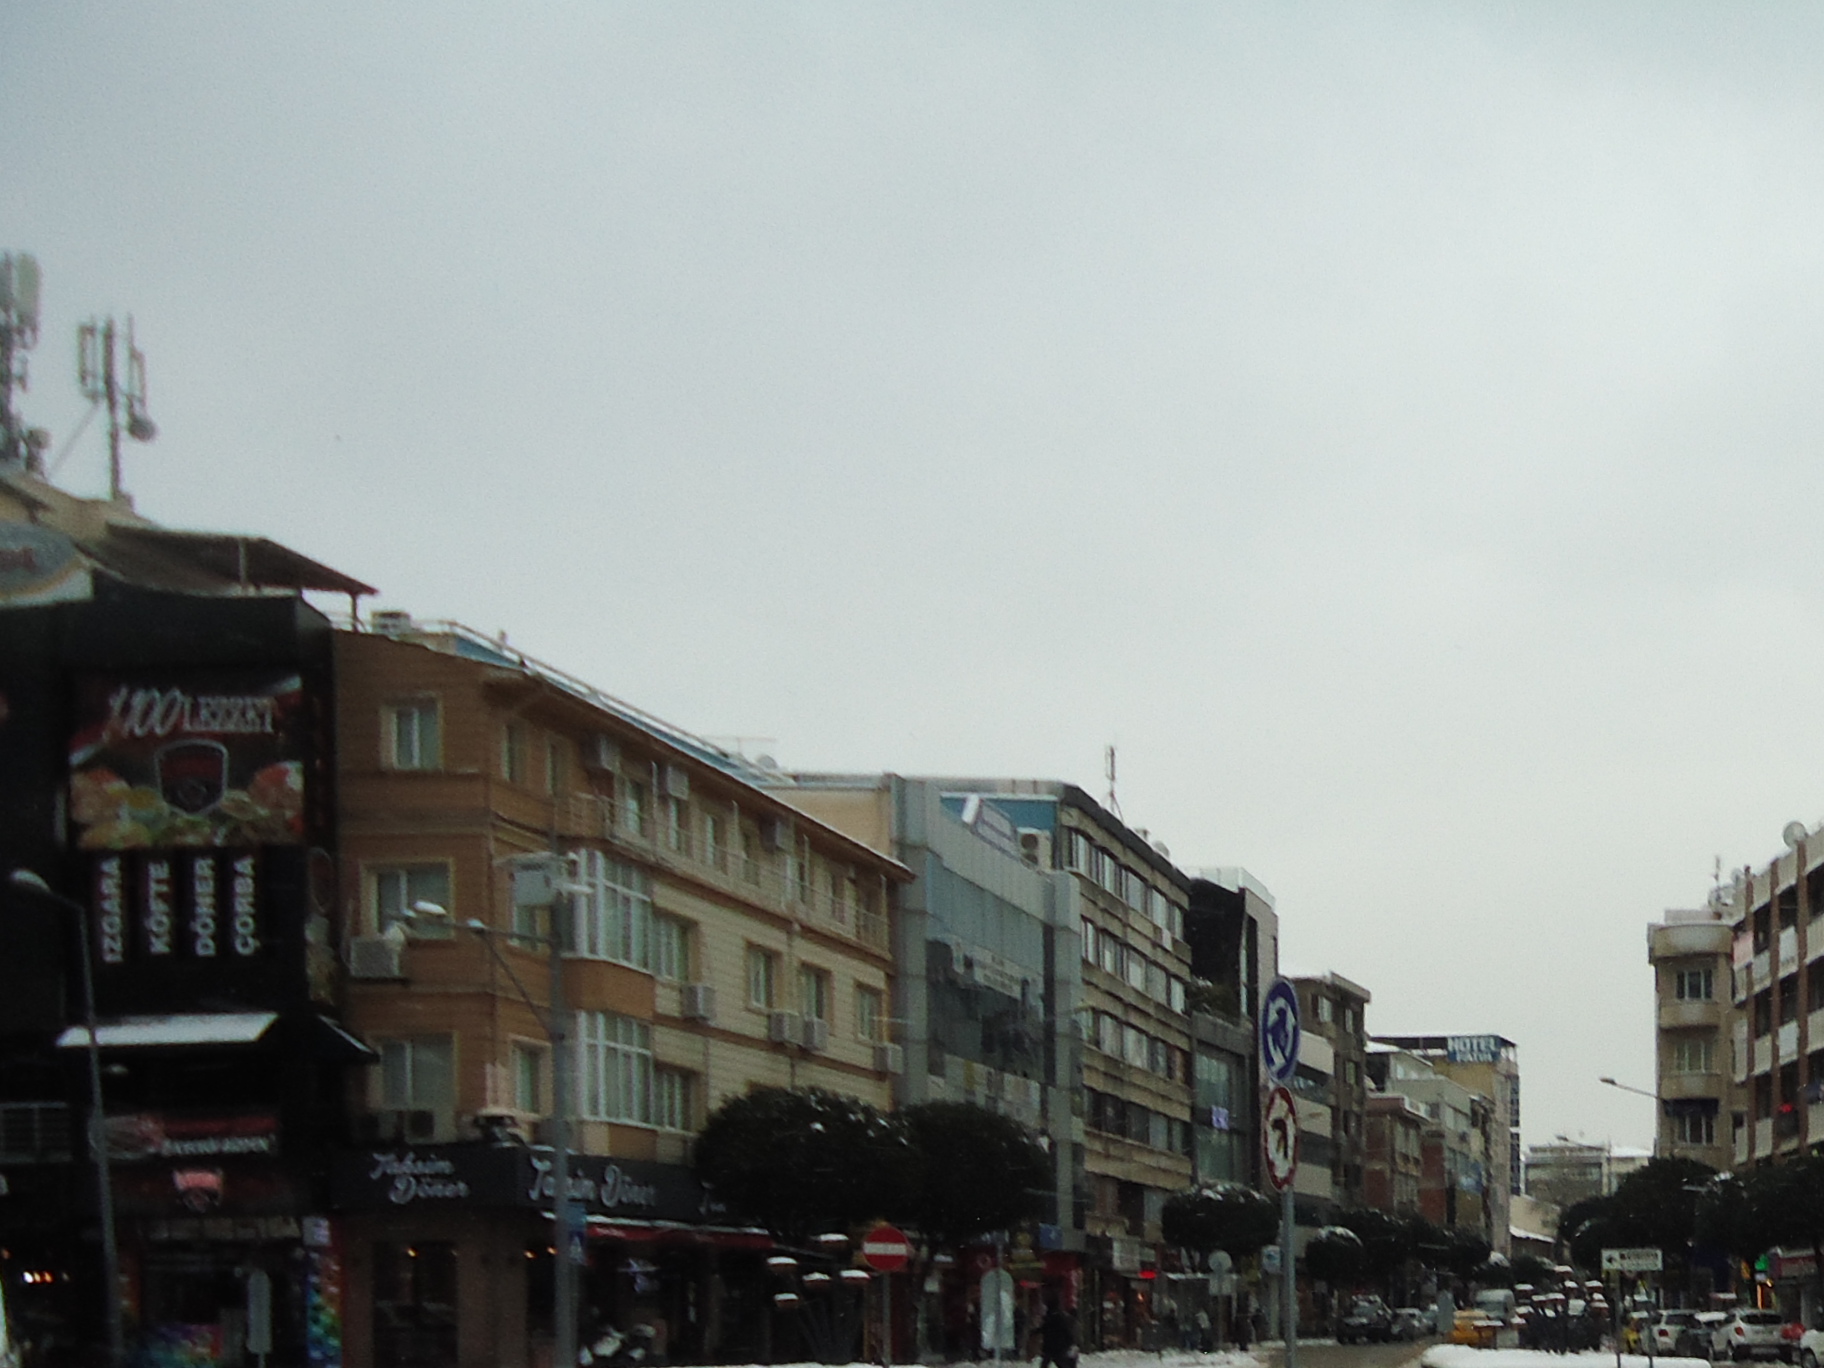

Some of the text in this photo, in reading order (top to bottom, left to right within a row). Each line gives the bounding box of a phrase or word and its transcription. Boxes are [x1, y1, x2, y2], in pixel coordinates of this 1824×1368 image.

[143, 859, 172, 955] KÖFTE
[190, 857, 217, 957] DÖNER
[234, 855, 261, 956] ÇORBA
[1447, 1037, 1496, 1052] HOTEL
[389, 1174, 472, 1205] Döner
[528, 1155, 596, 1201] Tasin
